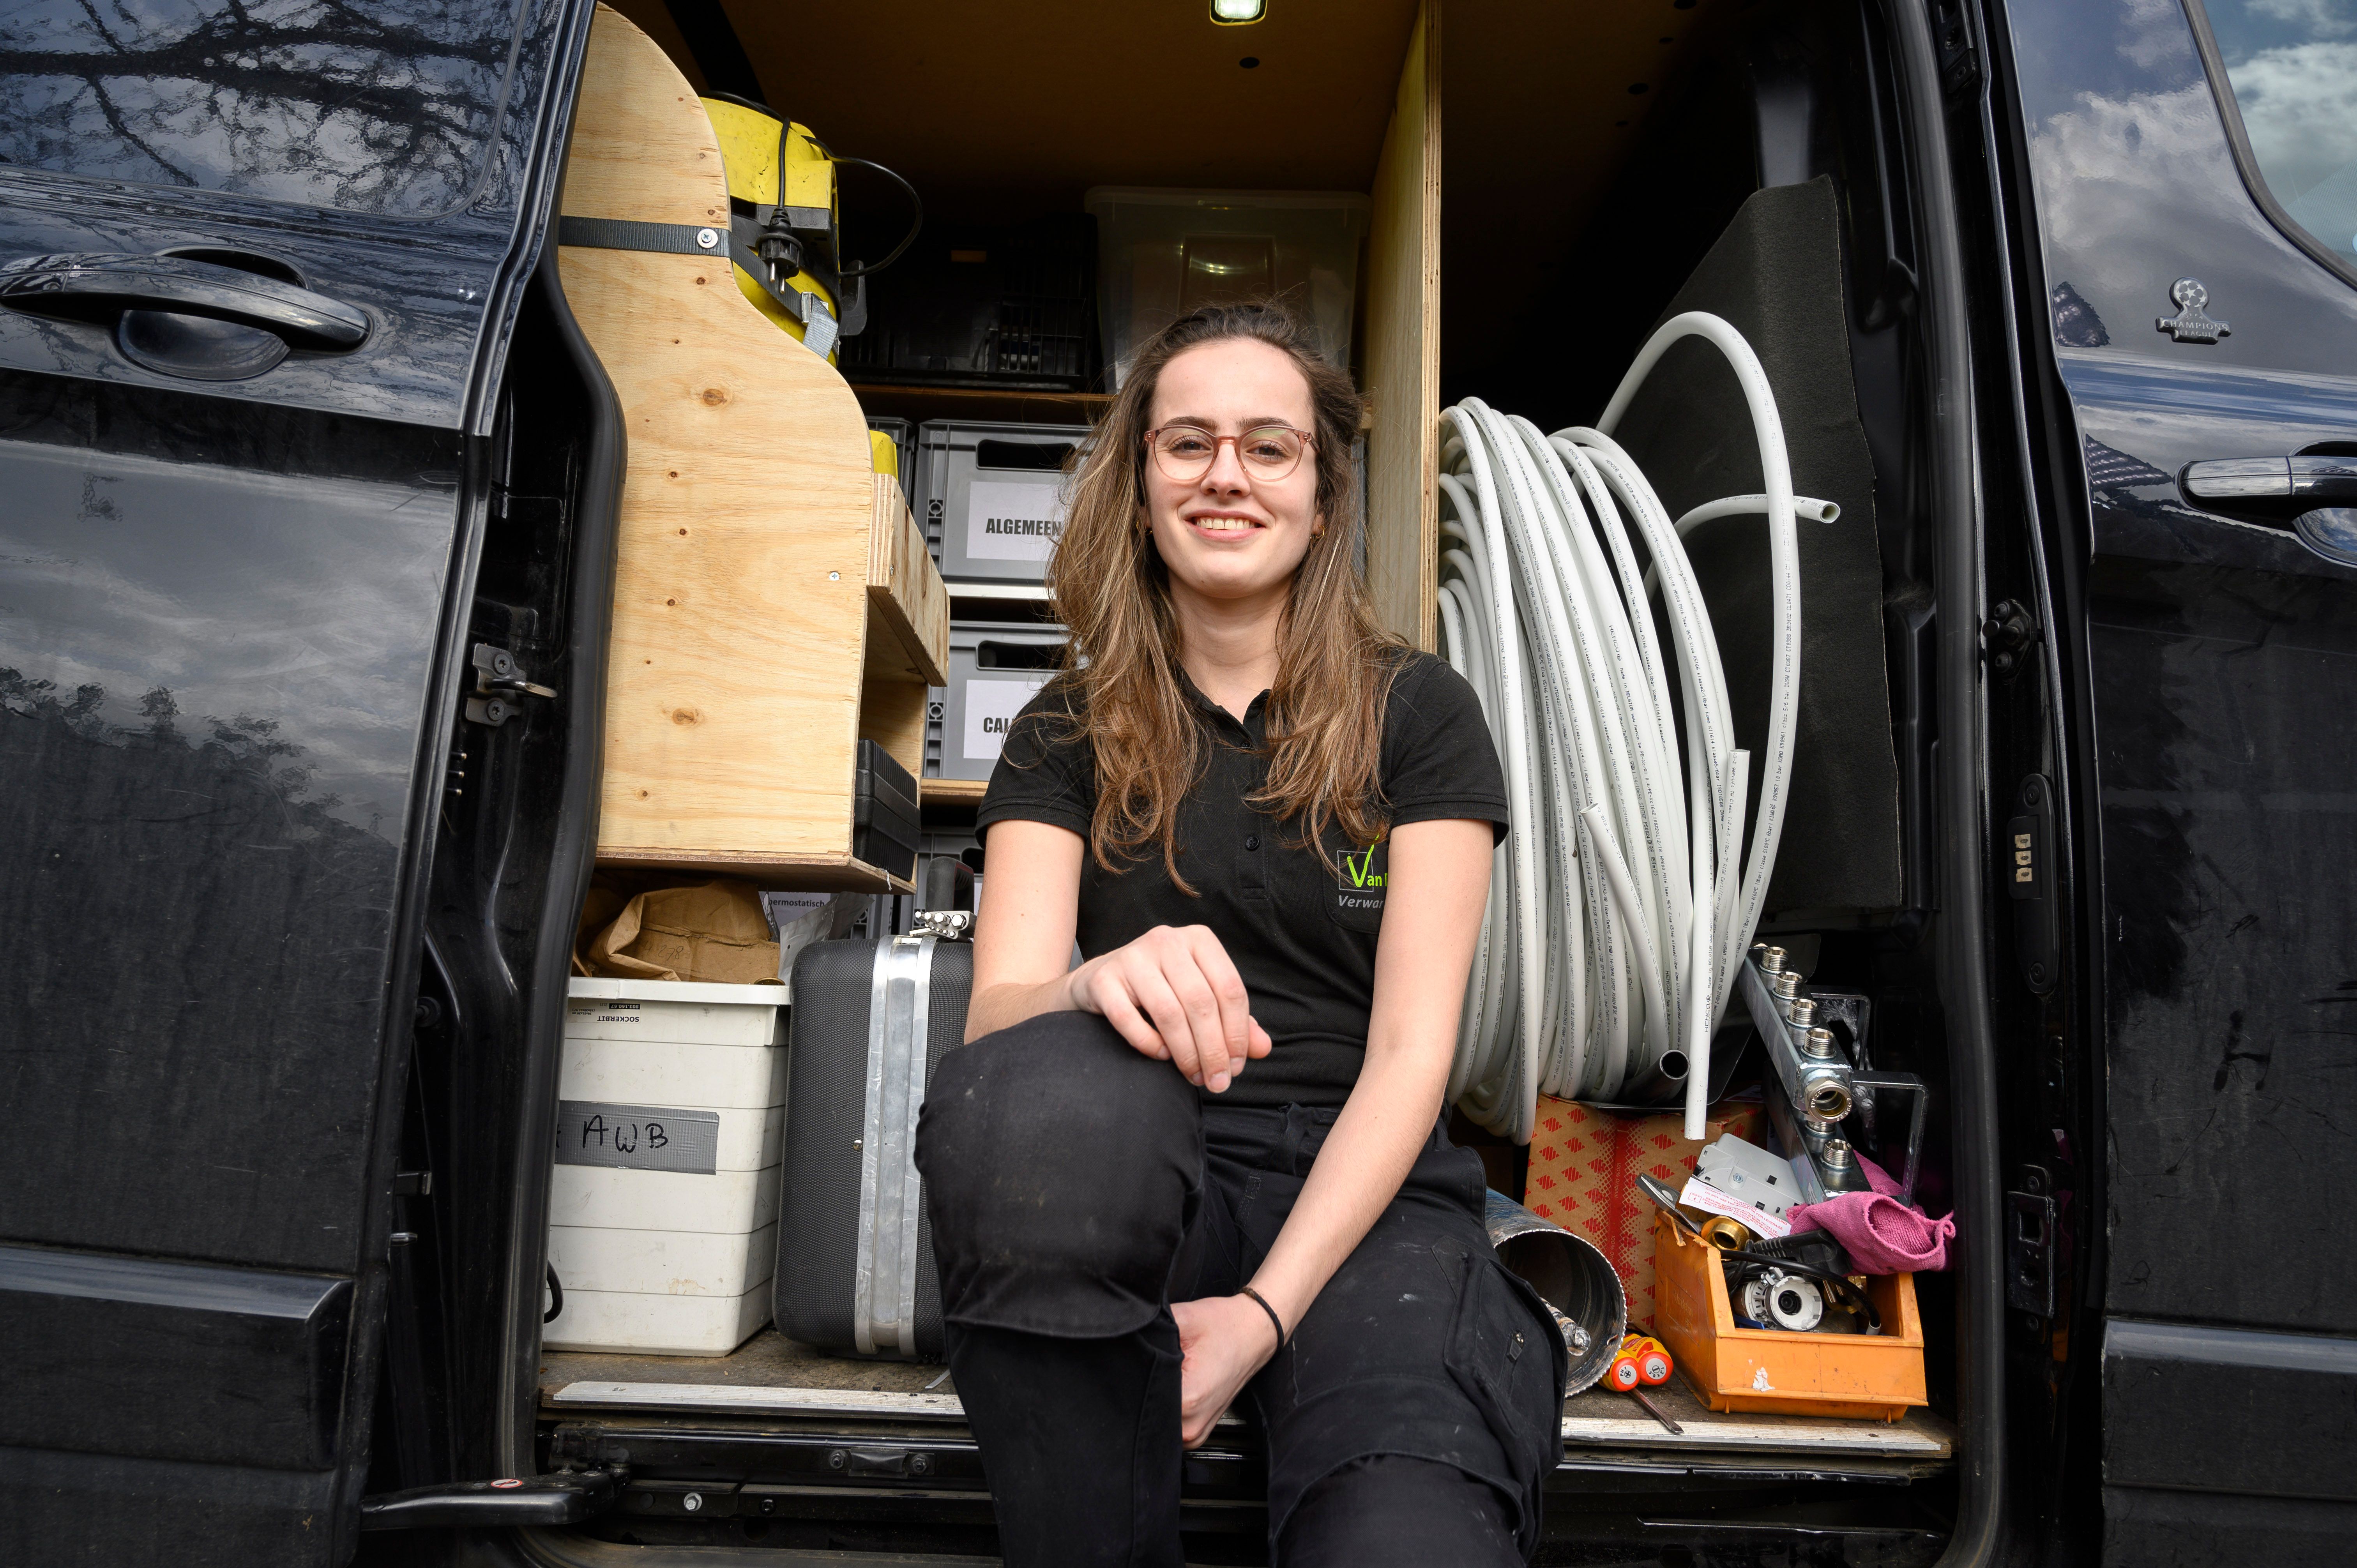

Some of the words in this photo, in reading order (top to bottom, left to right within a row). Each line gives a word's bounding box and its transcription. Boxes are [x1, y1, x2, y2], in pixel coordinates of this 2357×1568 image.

[2162, 320, 2228, 331] CHAMPIONS
[983, 717, 1014, 733] CAL
[1625, 690, 1634, 712] BELGIUM
[1631, 713, 1642, 749] www.henco.be
[1639, 802, 1647, 819] SINTEF
[1347, 833, 1382, 887] Van
[658, 945, 684, 961] 278
[582, 1114, 668, 1153] AWB
[1702, 1198, 1717, 1207] ENSURE
[1706, 1197, 1721, 1206] BEFORE
[1758, 1225, 1768, 1233] OPEN
[1763, 1217, 1783, 1231] LEVERAGE.
